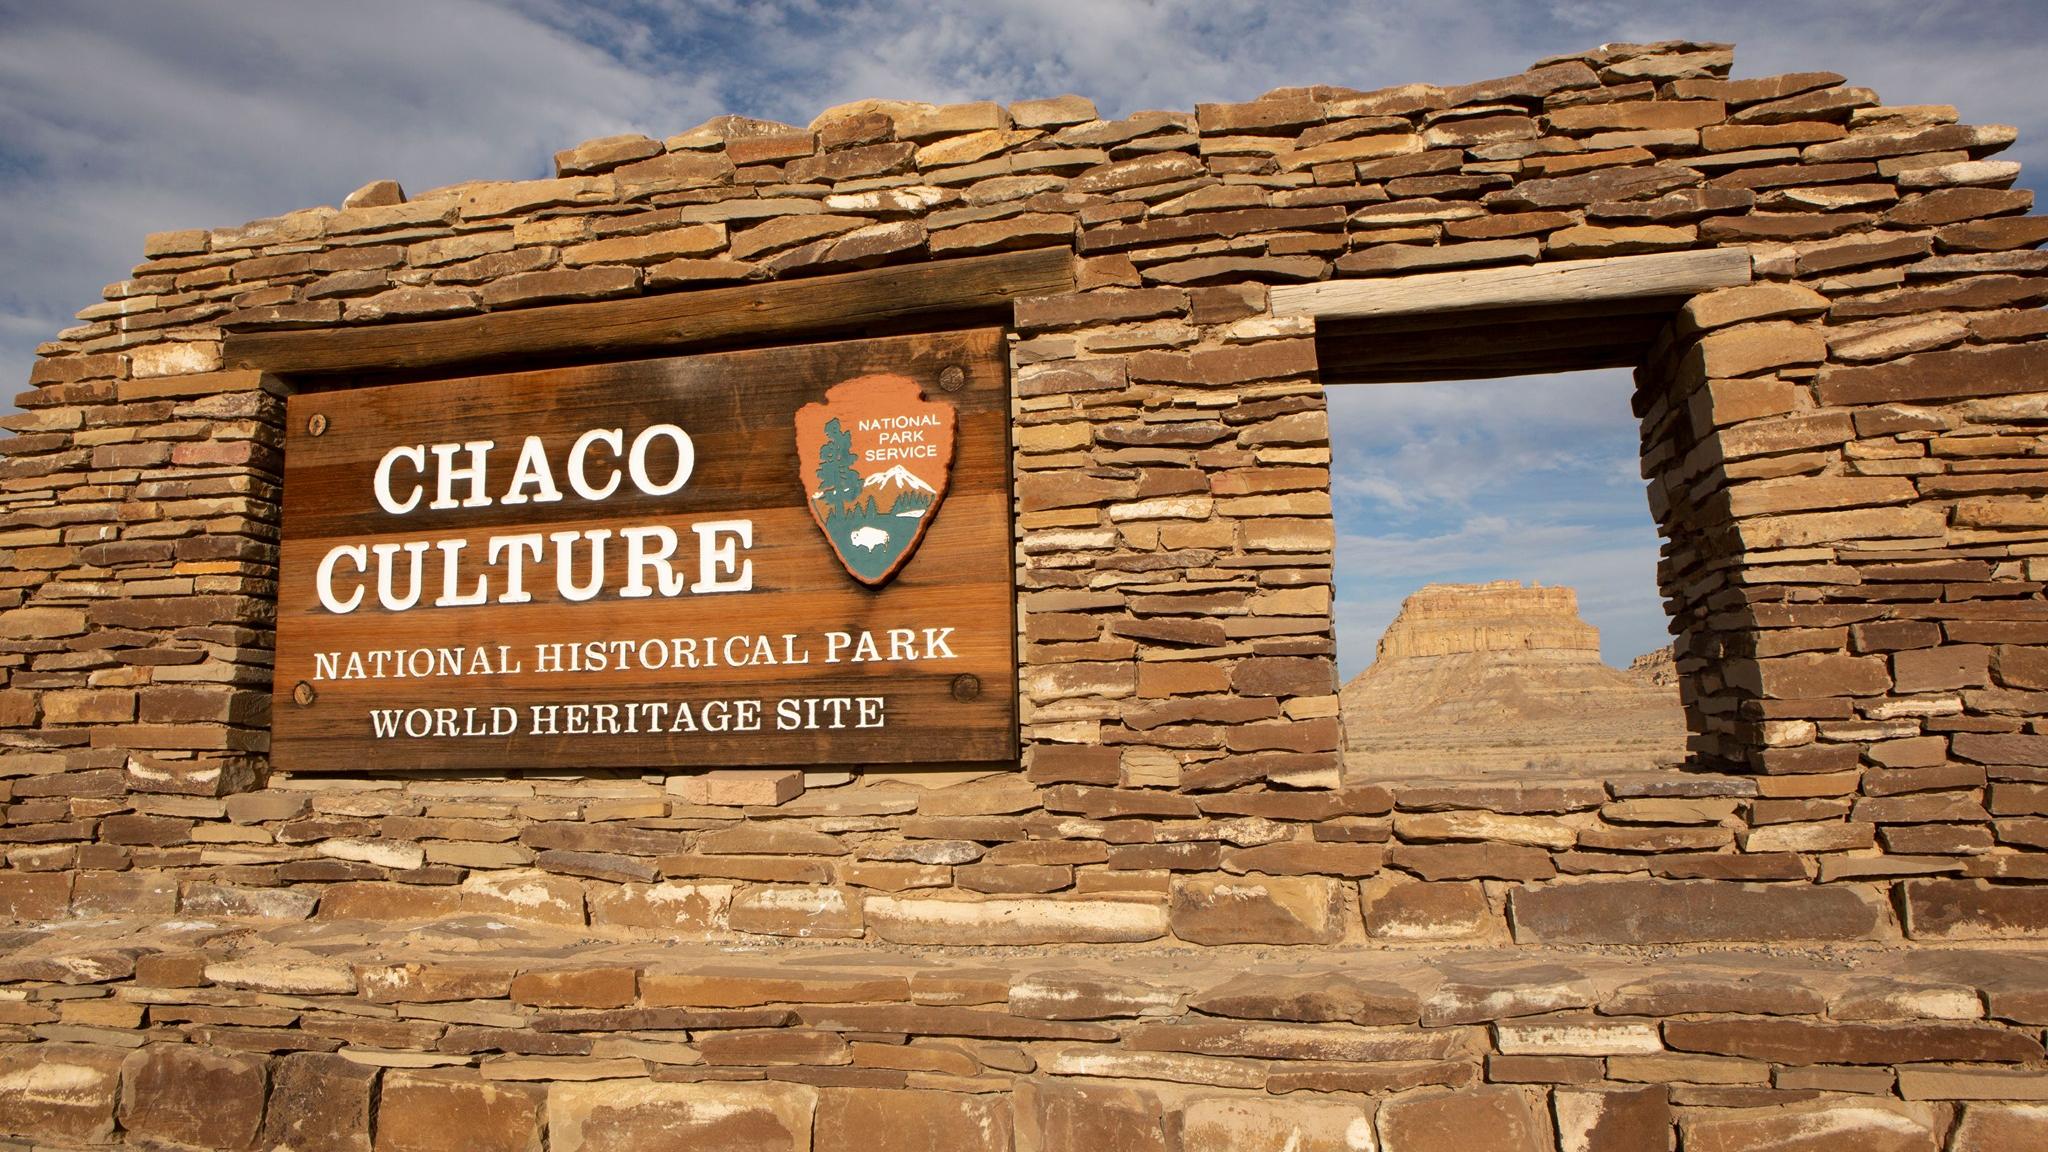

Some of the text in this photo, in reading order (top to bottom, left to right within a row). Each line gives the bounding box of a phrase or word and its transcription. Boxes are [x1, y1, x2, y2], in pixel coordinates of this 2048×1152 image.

[858, 414, 941, 431] NATIONAL
[879, 430, 924, 445] PARK
[373, 424, 695, 515] CHACO
[865, 444, 937, 462] SERVICE
[316, 519, 753, 614] CULTURE
[313, 627, 958, 680] NATIONAL HISTORICAL PARK
[369, 697, 884, 738] WORLD HERITAGE SITE
